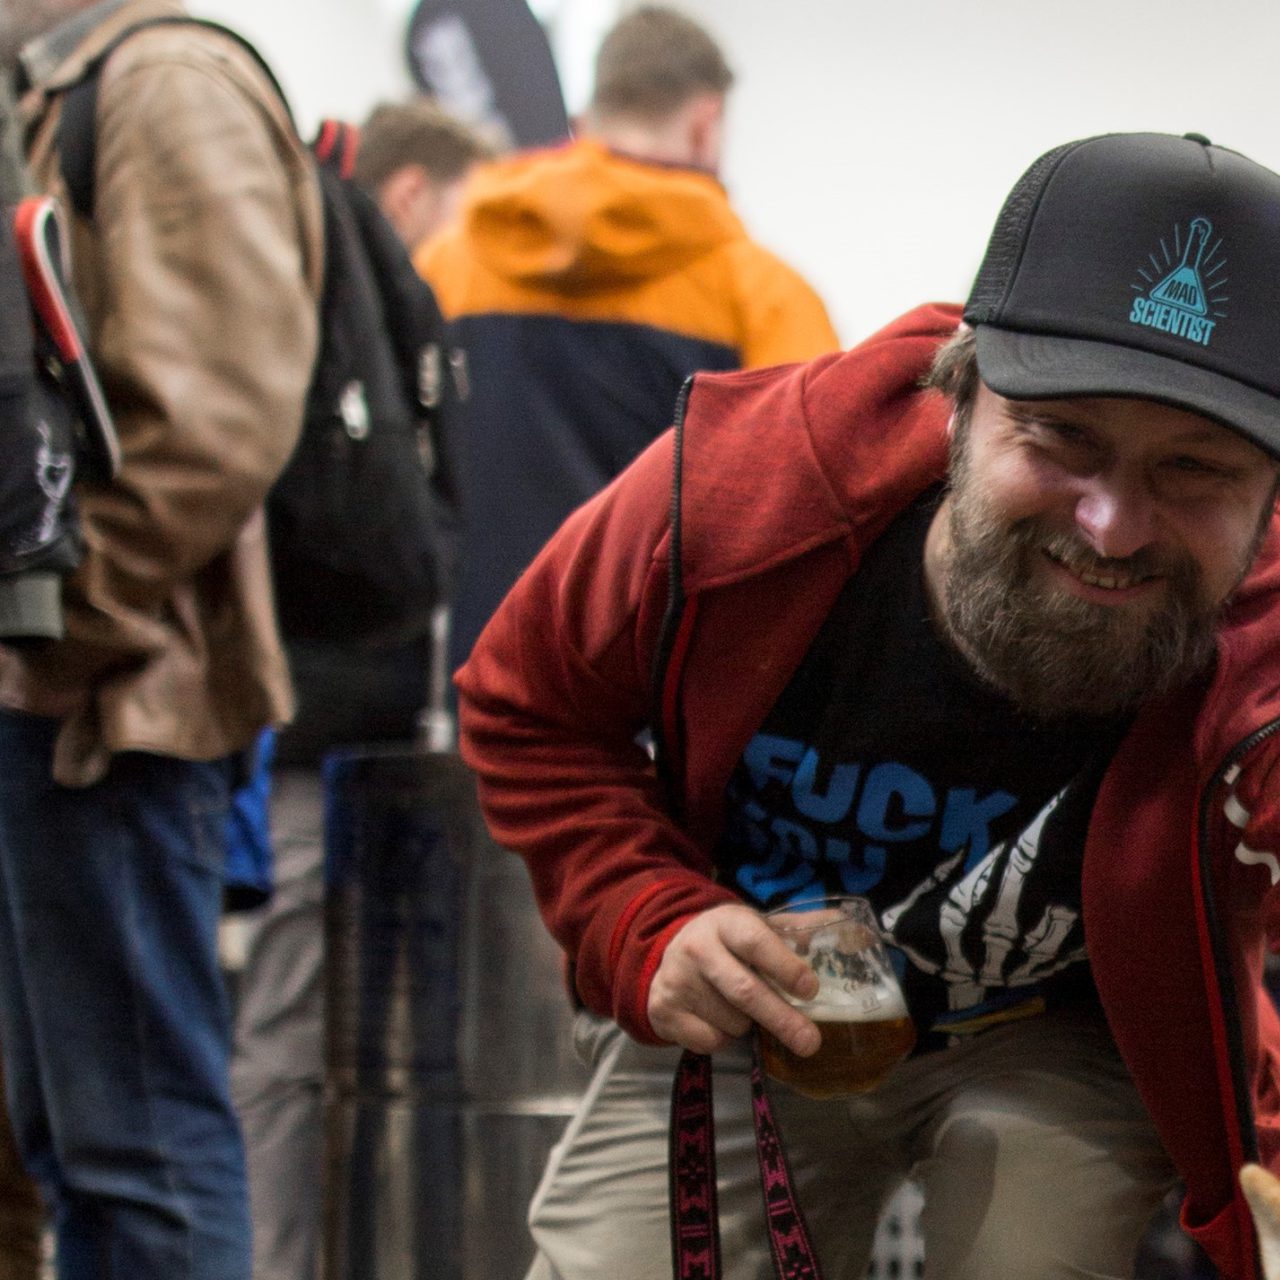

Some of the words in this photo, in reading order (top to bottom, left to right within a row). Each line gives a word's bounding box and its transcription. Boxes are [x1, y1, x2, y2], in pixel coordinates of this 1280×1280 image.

[1163, 280, 1198, 306] MAD
[1130, 298, 1215, 345] SCIENTIST
[743, 733, 1019, 876] FUCK
